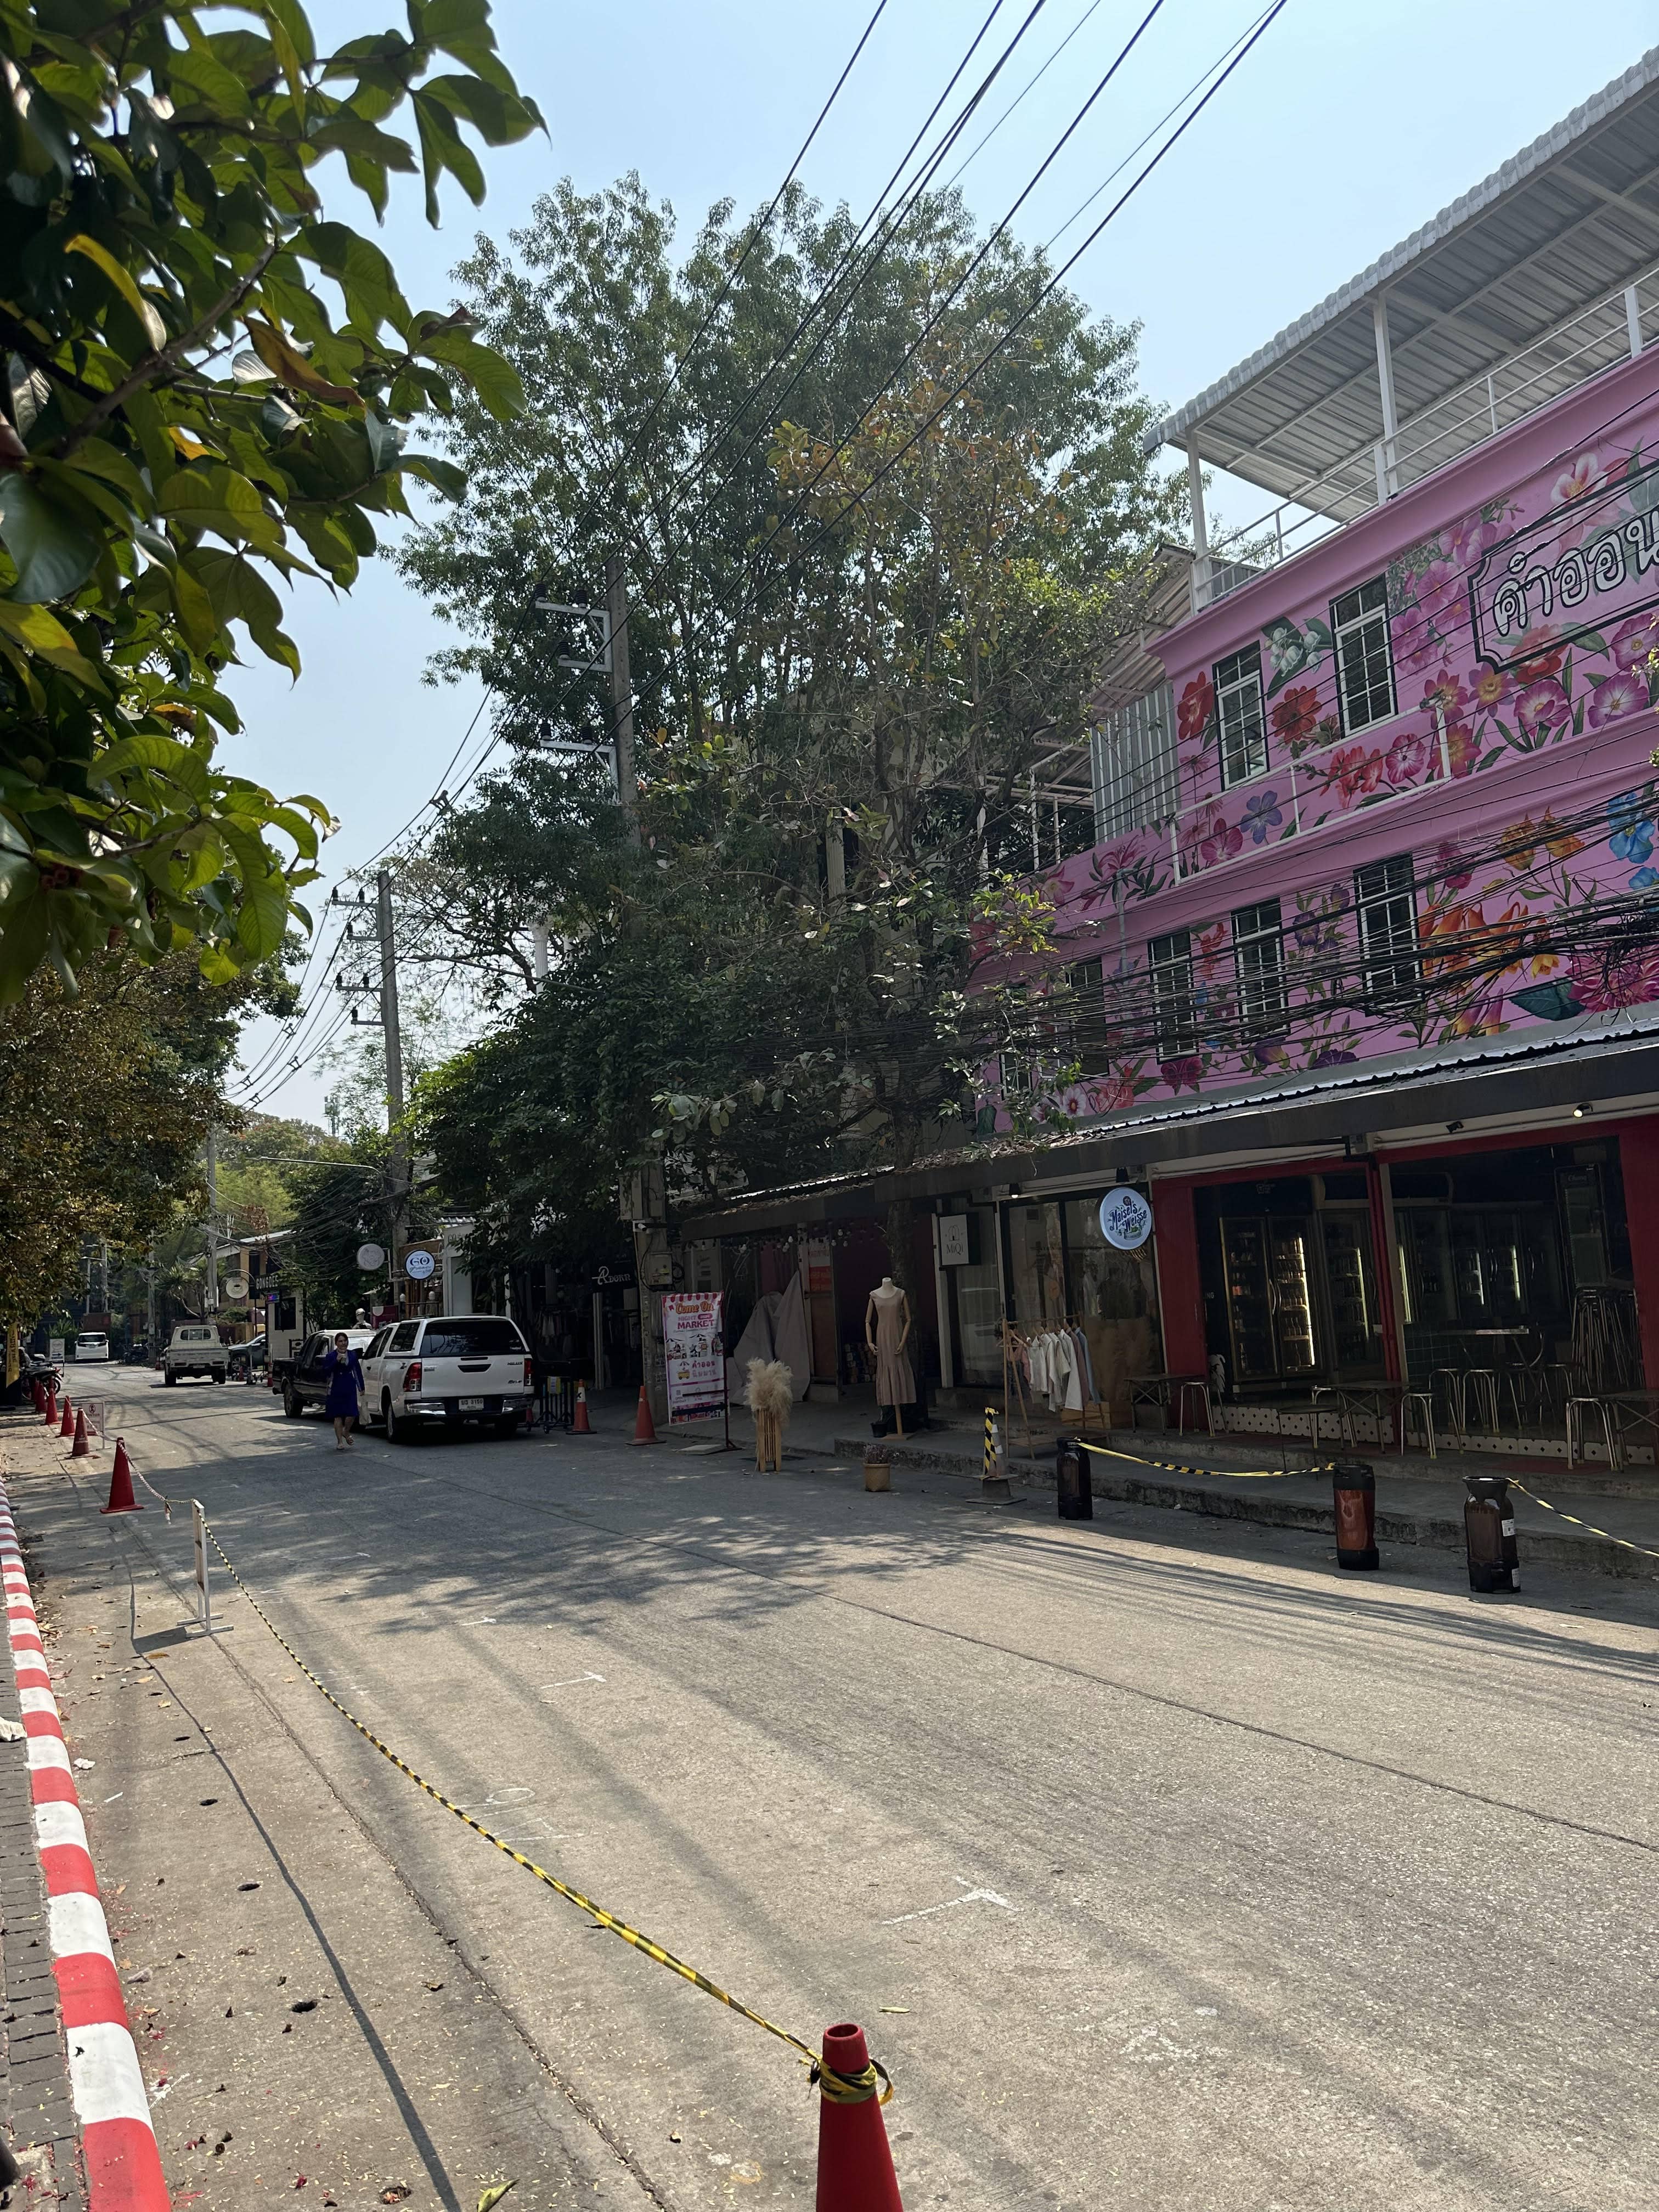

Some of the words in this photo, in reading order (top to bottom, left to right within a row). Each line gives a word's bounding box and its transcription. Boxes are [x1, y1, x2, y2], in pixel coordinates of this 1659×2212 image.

[1119, 1209, 1147, 1232] Weisse
[676, 1303, 699, 1314] Come
[700, 1301, 714, 1312] On
[678, 1319, 714, 1329] MARKET
